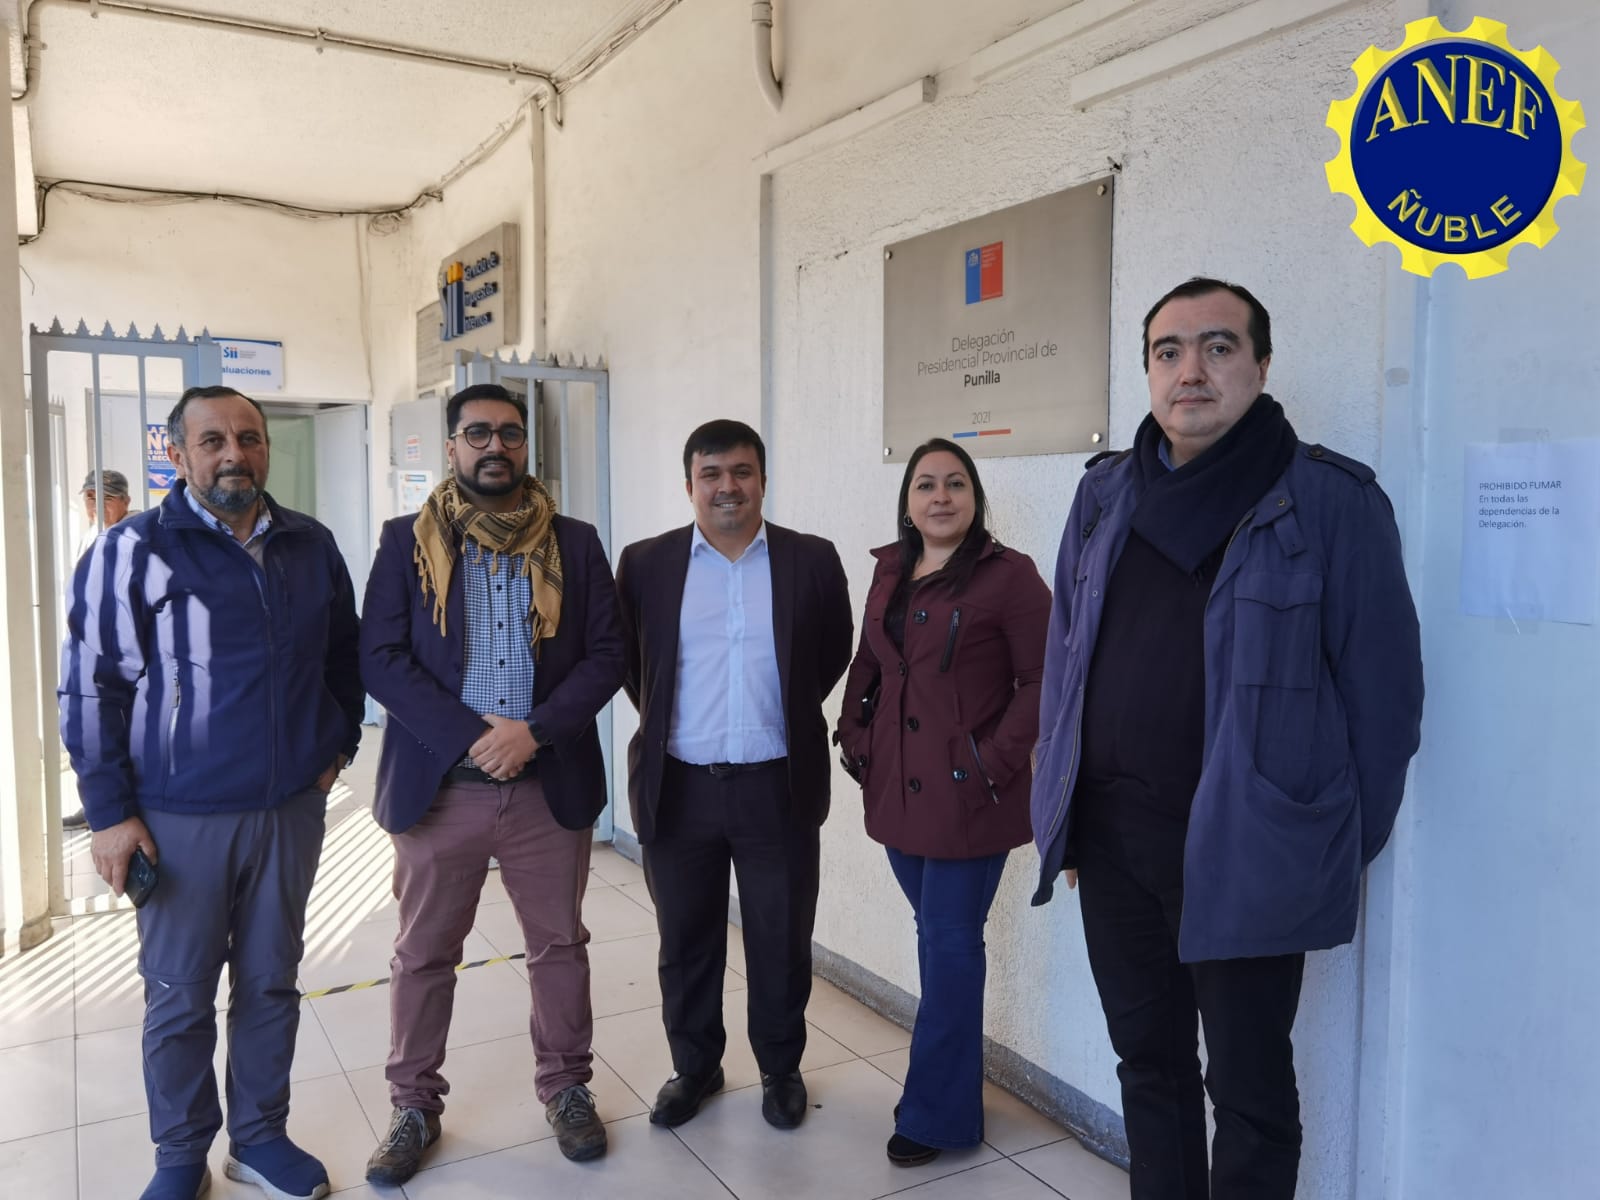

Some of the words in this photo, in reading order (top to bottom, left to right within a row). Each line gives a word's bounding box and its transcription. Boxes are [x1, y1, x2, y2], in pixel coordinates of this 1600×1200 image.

[951, 328, 1015, 353] Delegación
[917, 350, 979, 377] Presidencial
[982, 342, 1038, 367] Provincial
[1040, 341, 1058, 357] de
[222, 366, 271, 376] aluaciones
[964, 370, 1001, 388] Punilla
[971, 411, 991, 425] 2021
[1479, 481, 1527, 490] PROHIBIDO
[1529, 480, 1562, 489] FUMAR
[1479, 495, 1489, 503] En
[1491, 495, 1515, 503] todas
[1517, 494, 1529, 503] las
[1478, 507, 1537, 517] dependencias
[1539, 507, 1550, 515] de
[1552, 506, 1560, 515] la
[1478, 519, 1527, 530] Delegación.
